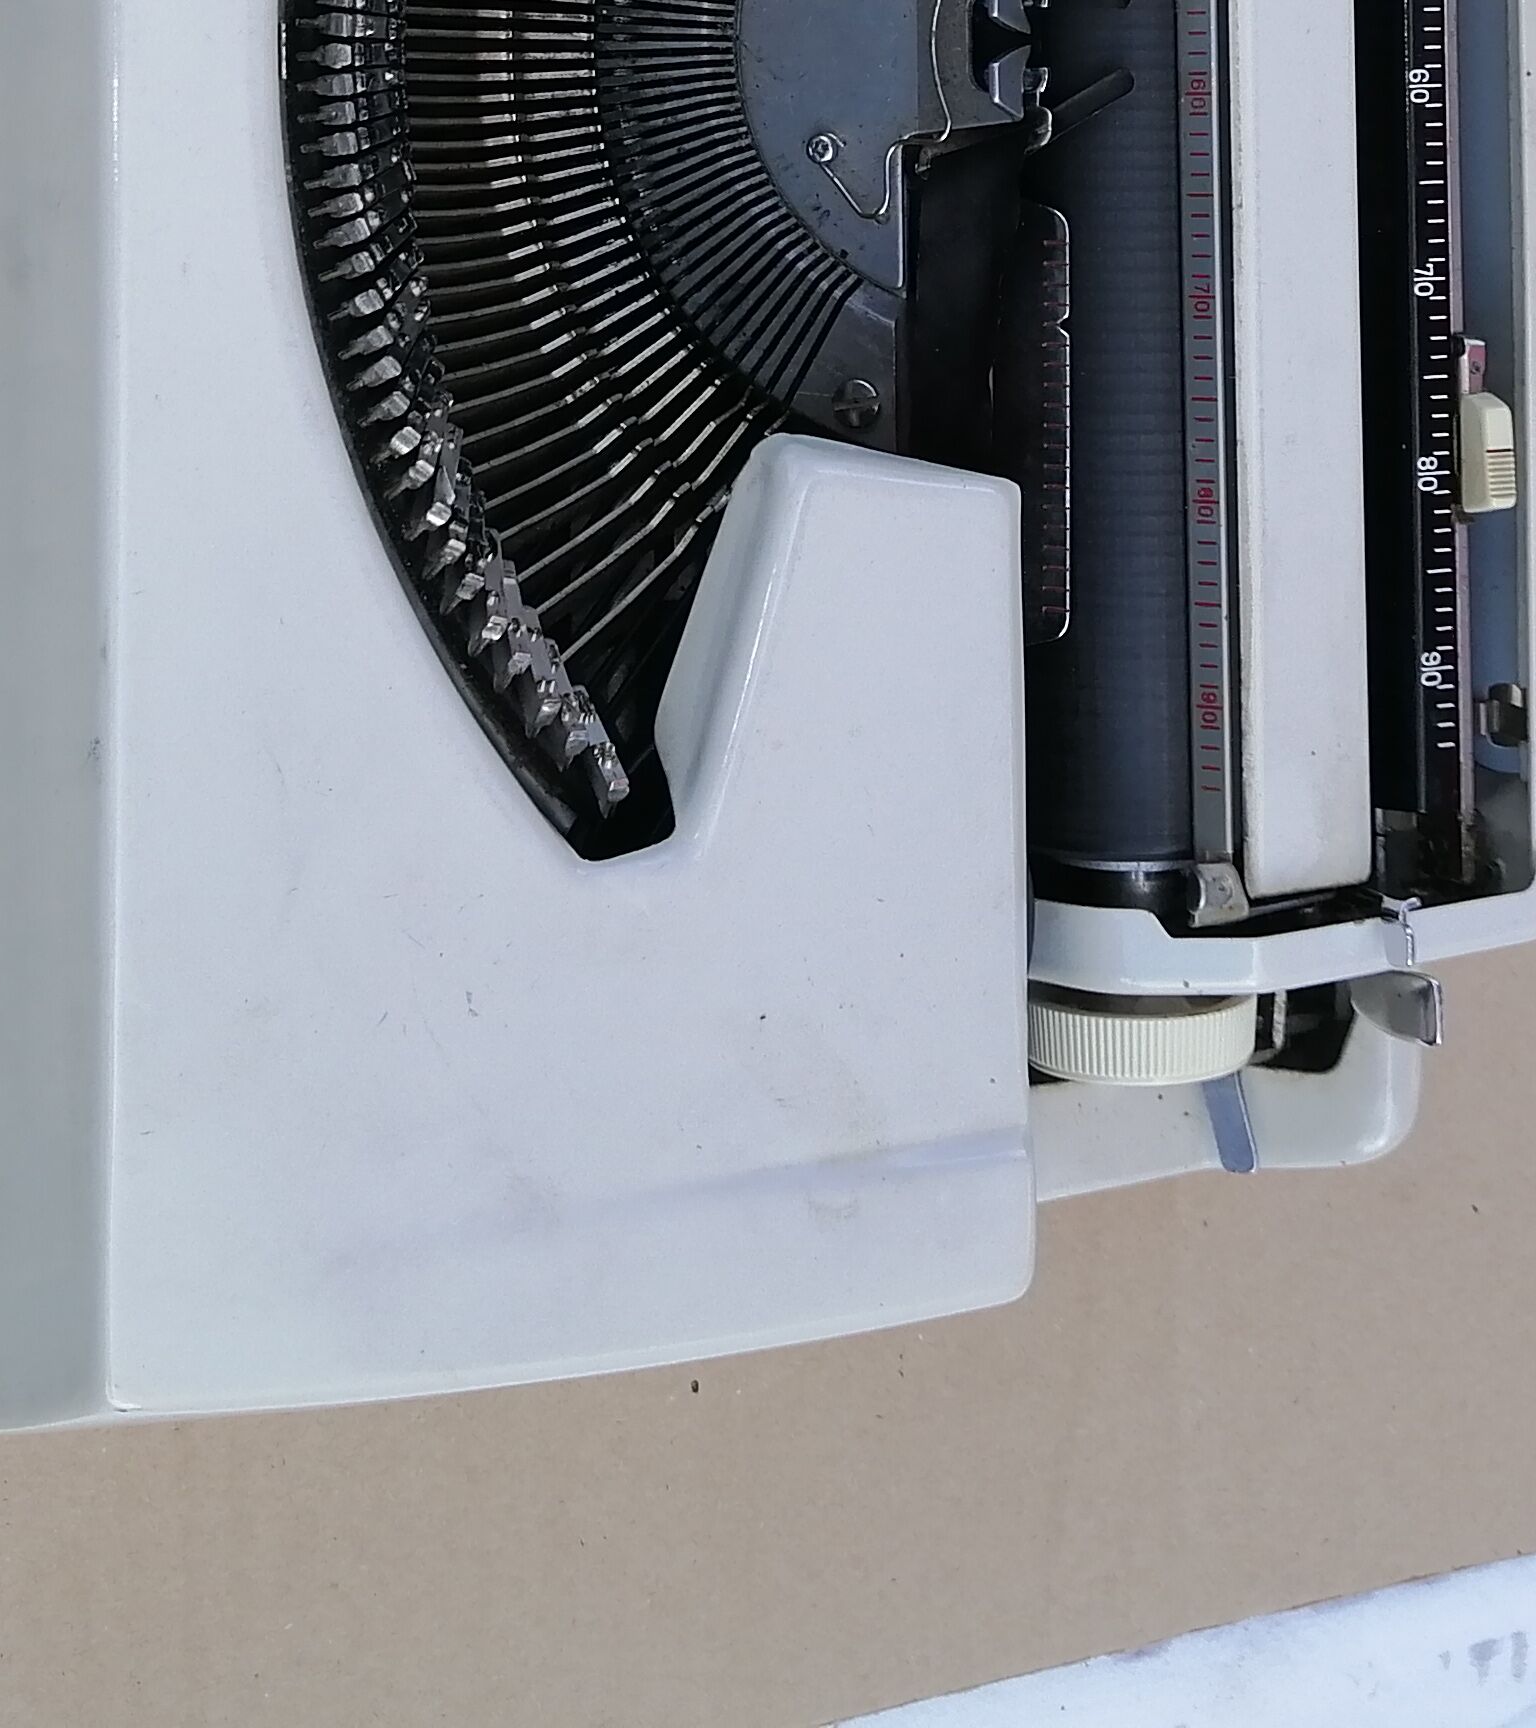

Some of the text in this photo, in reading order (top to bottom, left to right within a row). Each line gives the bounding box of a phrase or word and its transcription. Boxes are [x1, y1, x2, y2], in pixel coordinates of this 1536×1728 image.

[1188, 77, 1208, 110] 60
[1408, 68, 1431, 103] 60
[1413, 263, 1434, 297] 70
[1193, 282, 1213, 314] 70
[1417, 456, 1437, 491] 80
[1419, 651, 1442, 687] 90
[1198, 691, 1217, 724] 90
